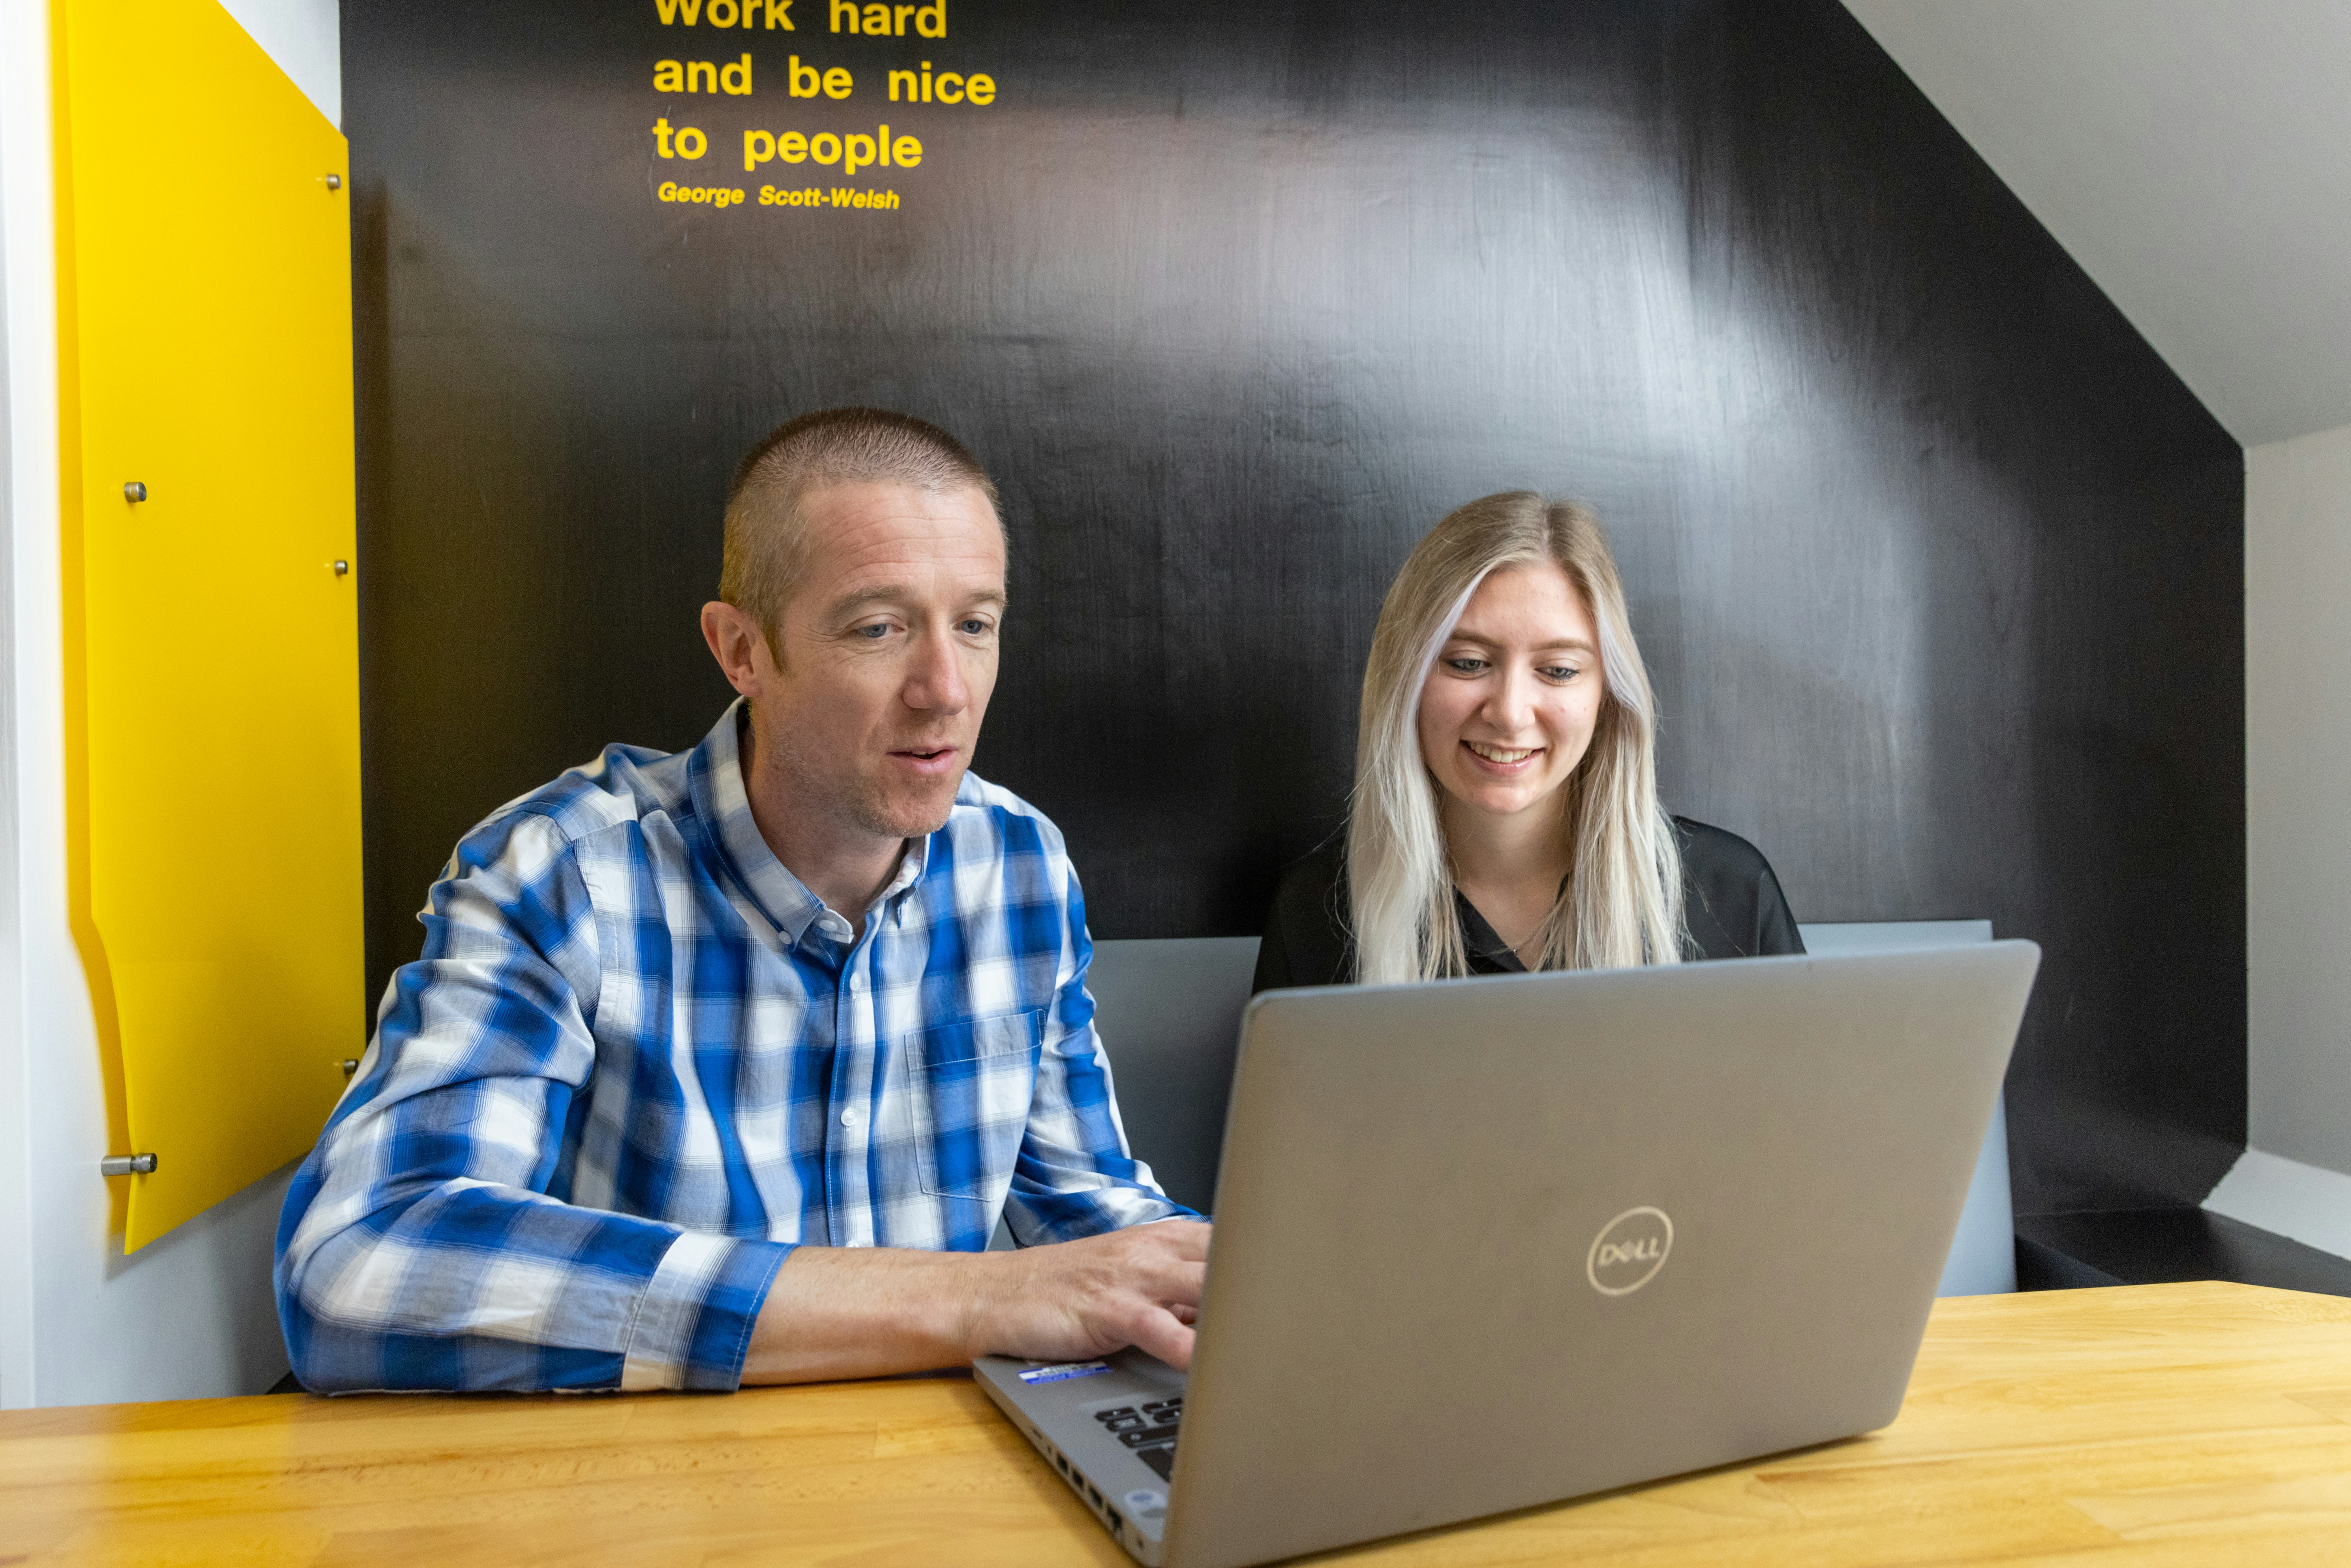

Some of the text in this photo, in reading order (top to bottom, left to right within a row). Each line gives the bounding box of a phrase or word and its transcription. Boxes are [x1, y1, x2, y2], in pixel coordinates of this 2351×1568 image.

[655, 0, 946, 38] Work hard
[653, 53, 996, 105] and be nice
[652, 118, 923, 175] to people
[658, 181, 900, 210] George Scott-Welsh
[1598, 1237, 1660, 1266] DELL
